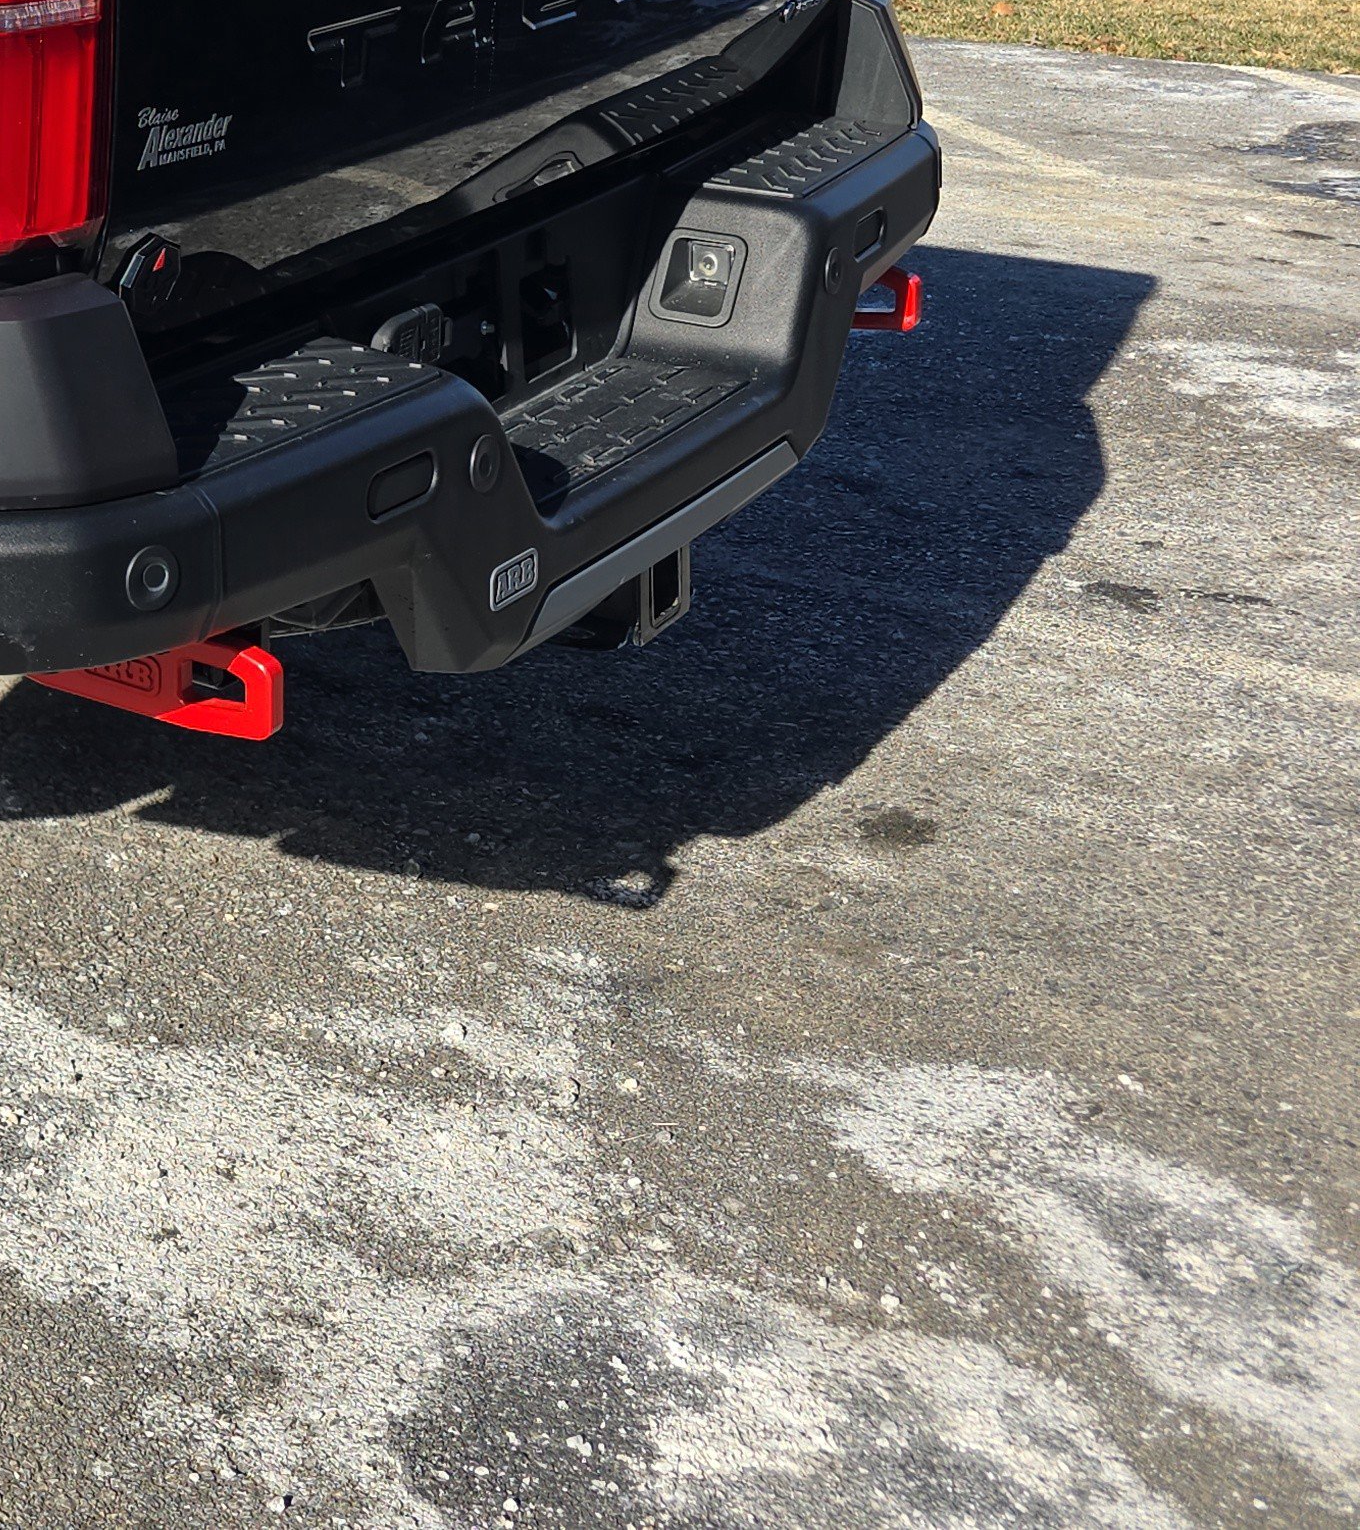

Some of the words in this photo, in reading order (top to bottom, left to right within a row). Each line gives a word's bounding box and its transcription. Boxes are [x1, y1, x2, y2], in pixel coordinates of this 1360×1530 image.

[138, 106, 179, 128] Blaise
[137, 113, 233, 170] Alexander
[159, 143, 212, 166] MANSFIELD,
[214, 138, 227, 152] PA
[496, 557, 534, 603] ARB
